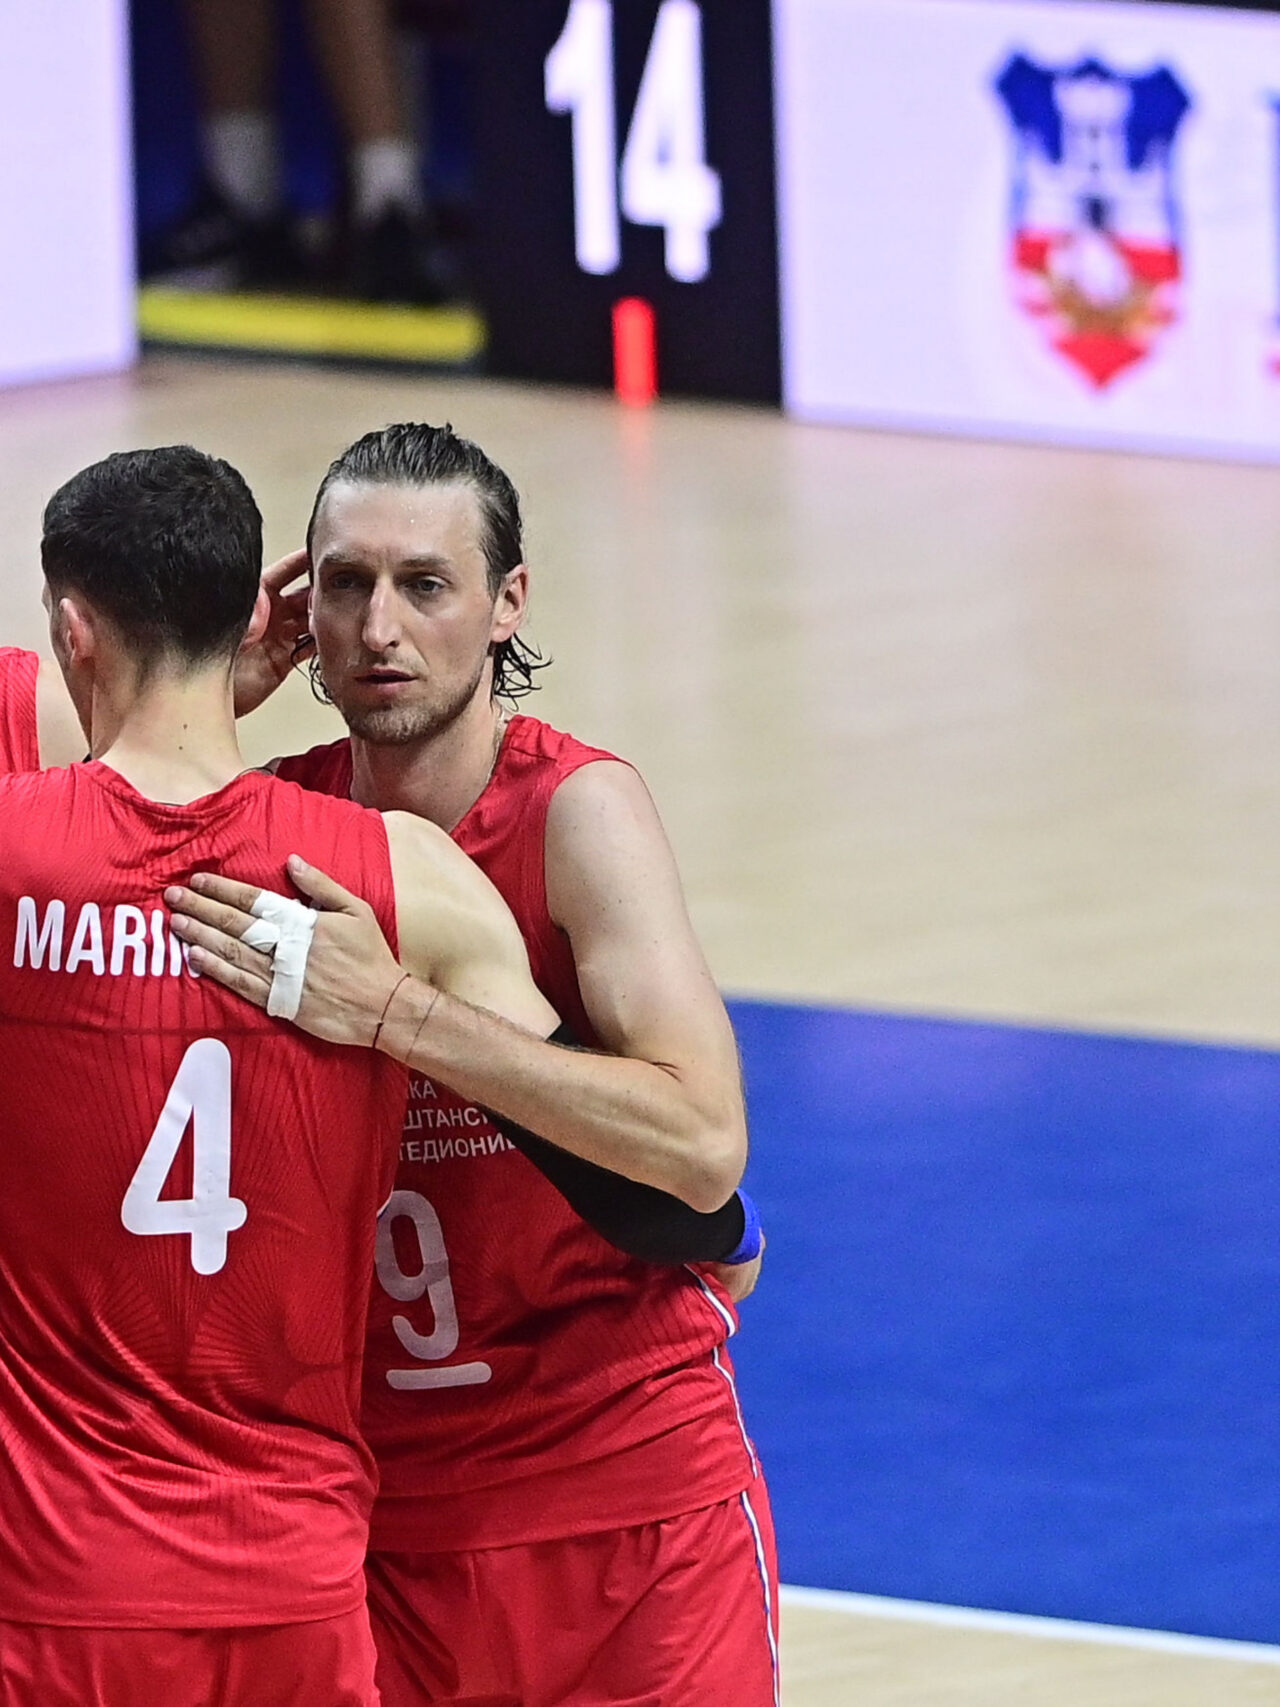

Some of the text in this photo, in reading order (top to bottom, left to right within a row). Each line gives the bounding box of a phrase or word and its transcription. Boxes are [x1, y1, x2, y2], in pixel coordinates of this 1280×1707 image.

[544, 0, 723, 283] 14
[121, 1037, 247, 1275] 4
[376, 1189, 459, 1361] 9
